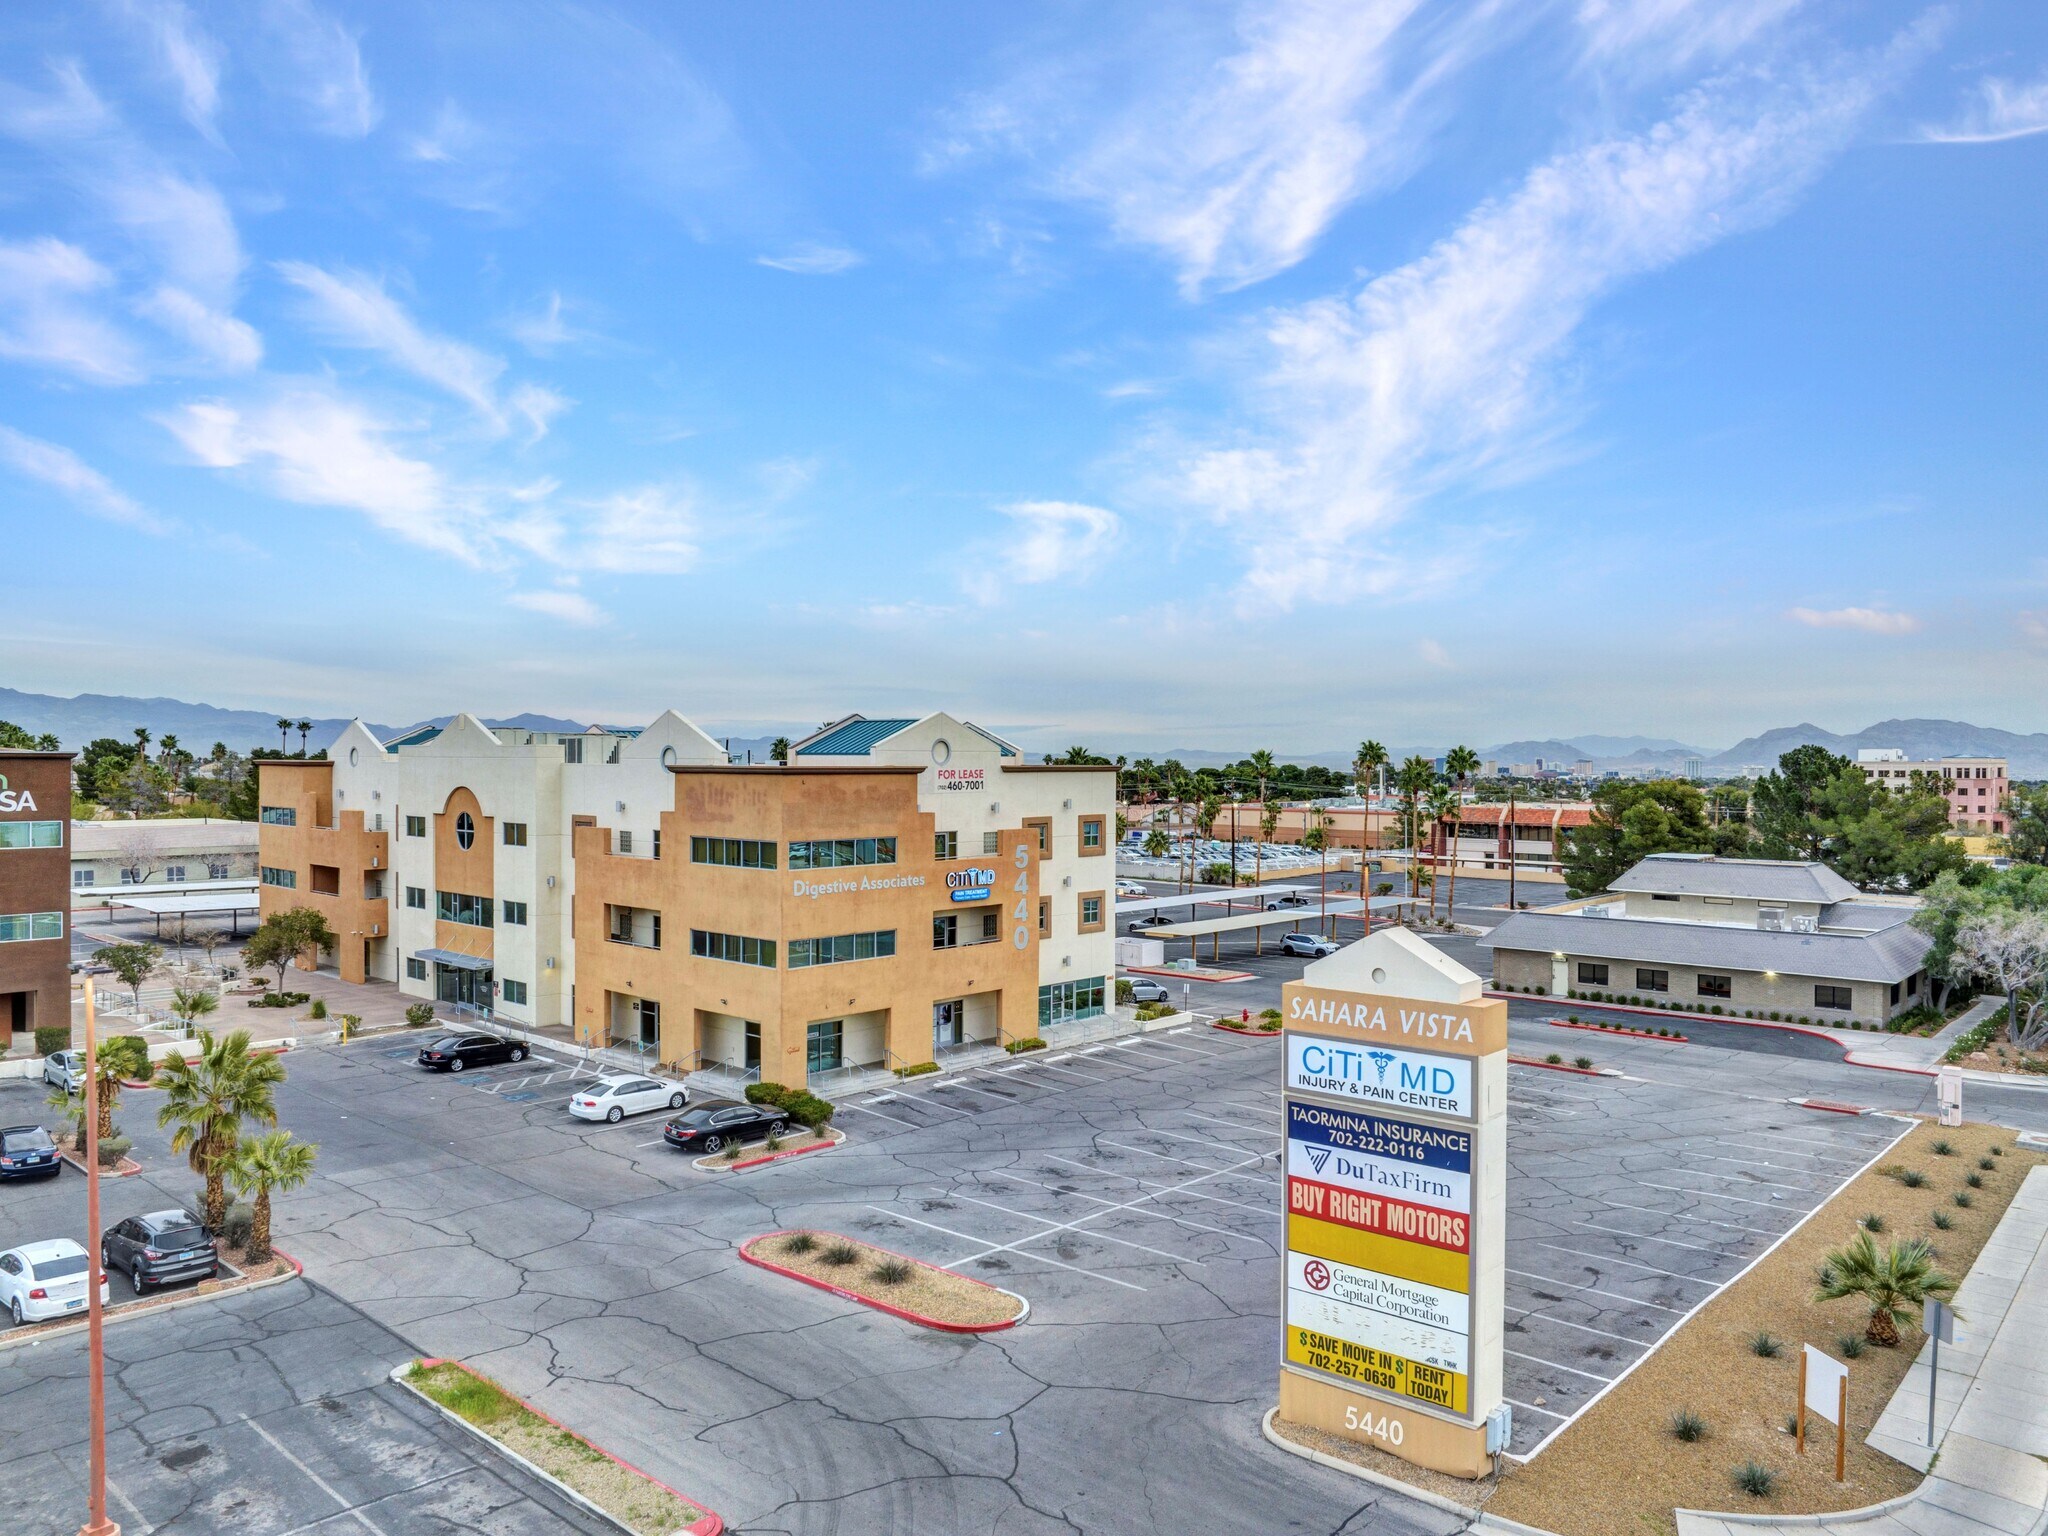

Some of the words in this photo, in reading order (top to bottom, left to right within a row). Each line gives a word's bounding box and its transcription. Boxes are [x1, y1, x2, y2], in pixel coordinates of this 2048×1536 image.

[938, 770, 956, 780] FOR
[958, 770, 984, 779] LEASE
[948, 780, 984, 790] 460-7001
[794, 878, 858, 900] Digestive
[860, 874, 925, 890] Associates
[978, 870, 996, 885] MD
[1290, 996, 1387, 1031] SAHARA
[1400, 1010, 1474, 1042] VISTA
[1299, 1074, 1346, 1092] INJURY
[1350, 1083, 1358, 1094] &
[1363, 1086, 1394, 1100] PAIN
[1400, 1091, 1458, 1112] CENTER
[1400, 1062, 1454, 1094] MD
[1292, 1106, 1370, 1135] TAORMINA
[1374, 1122, 1468, 1152] INSURANCE
[1329, 1130, 1424, 1160] 702-222-0116
[1336, 1157, 1452, 1198] DuTaxFirm
[1292, 1182, 1325, 1214] BUY
[1330, 1190, 1382, 1228] RIGHT
[1387, 1202, 1465, 1247] MOTORS
[1334, 1268, 1378, 1290] General
[1381, 1280, 1439, 1308] Mortgage
[1334, 1284, 1374, 1304] Capital
[1376, 1294, 1449, 1325] Corporation
[1300, 1331, 1308, 1346] $
[1310, 1334, 1338, 1354] SAVE
[1342, 1342, 1376, 1365] MOVE
[1380, 1354, 1392, 1371] IN
[1396, 1358, 1404, 1374] $
[1308, 1351, 1396, 1390] 702-257-0630
[1410, 1380, 1448, 1404] TODAY
[1414, 1365, 1446, 1386] RENT
[1345, 1405, 1404, 1446] 5440
